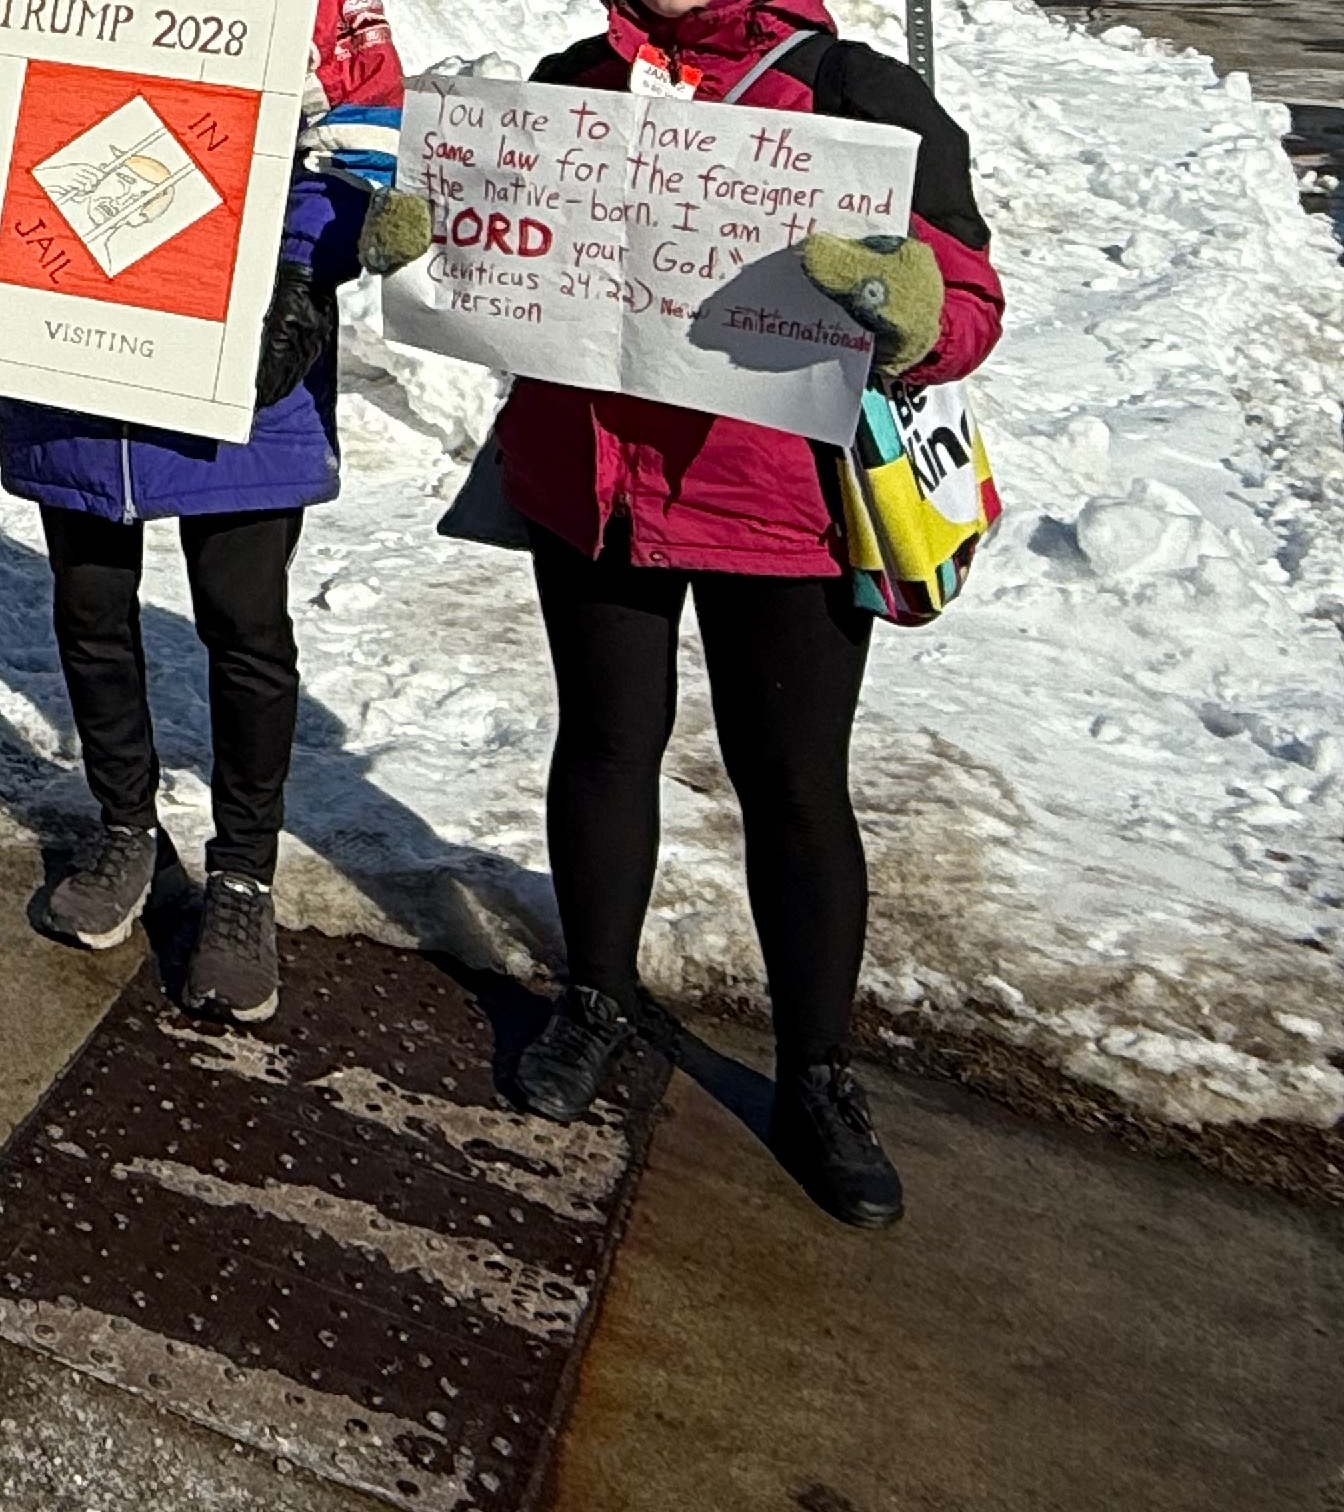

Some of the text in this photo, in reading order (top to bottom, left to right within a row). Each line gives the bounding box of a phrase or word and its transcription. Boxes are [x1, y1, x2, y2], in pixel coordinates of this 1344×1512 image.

[152, 9, 248, 58] 2028
[188, 112, 229, 151] IN
[500, 108, 549, 132] are
[569, 100, 610, 139] to
[639, 100, 717, 152] have
[750, 127, 812, 172] the
[420, 164, 465, 202] the
[672, 202, 701, 233] I
[720, 222, 760, 243] am
[497, 135, 540, 171] law
[555, 148, 609, 182] for
[627, 151, 684, 195] the
[697, 164, 824, 216] foreigner
[838, 188, 893, 216] and
[14, 219, 71, 284] JAIL
[573, 240, 629, 268] your
[44, 320, 154, 358] VISITING
